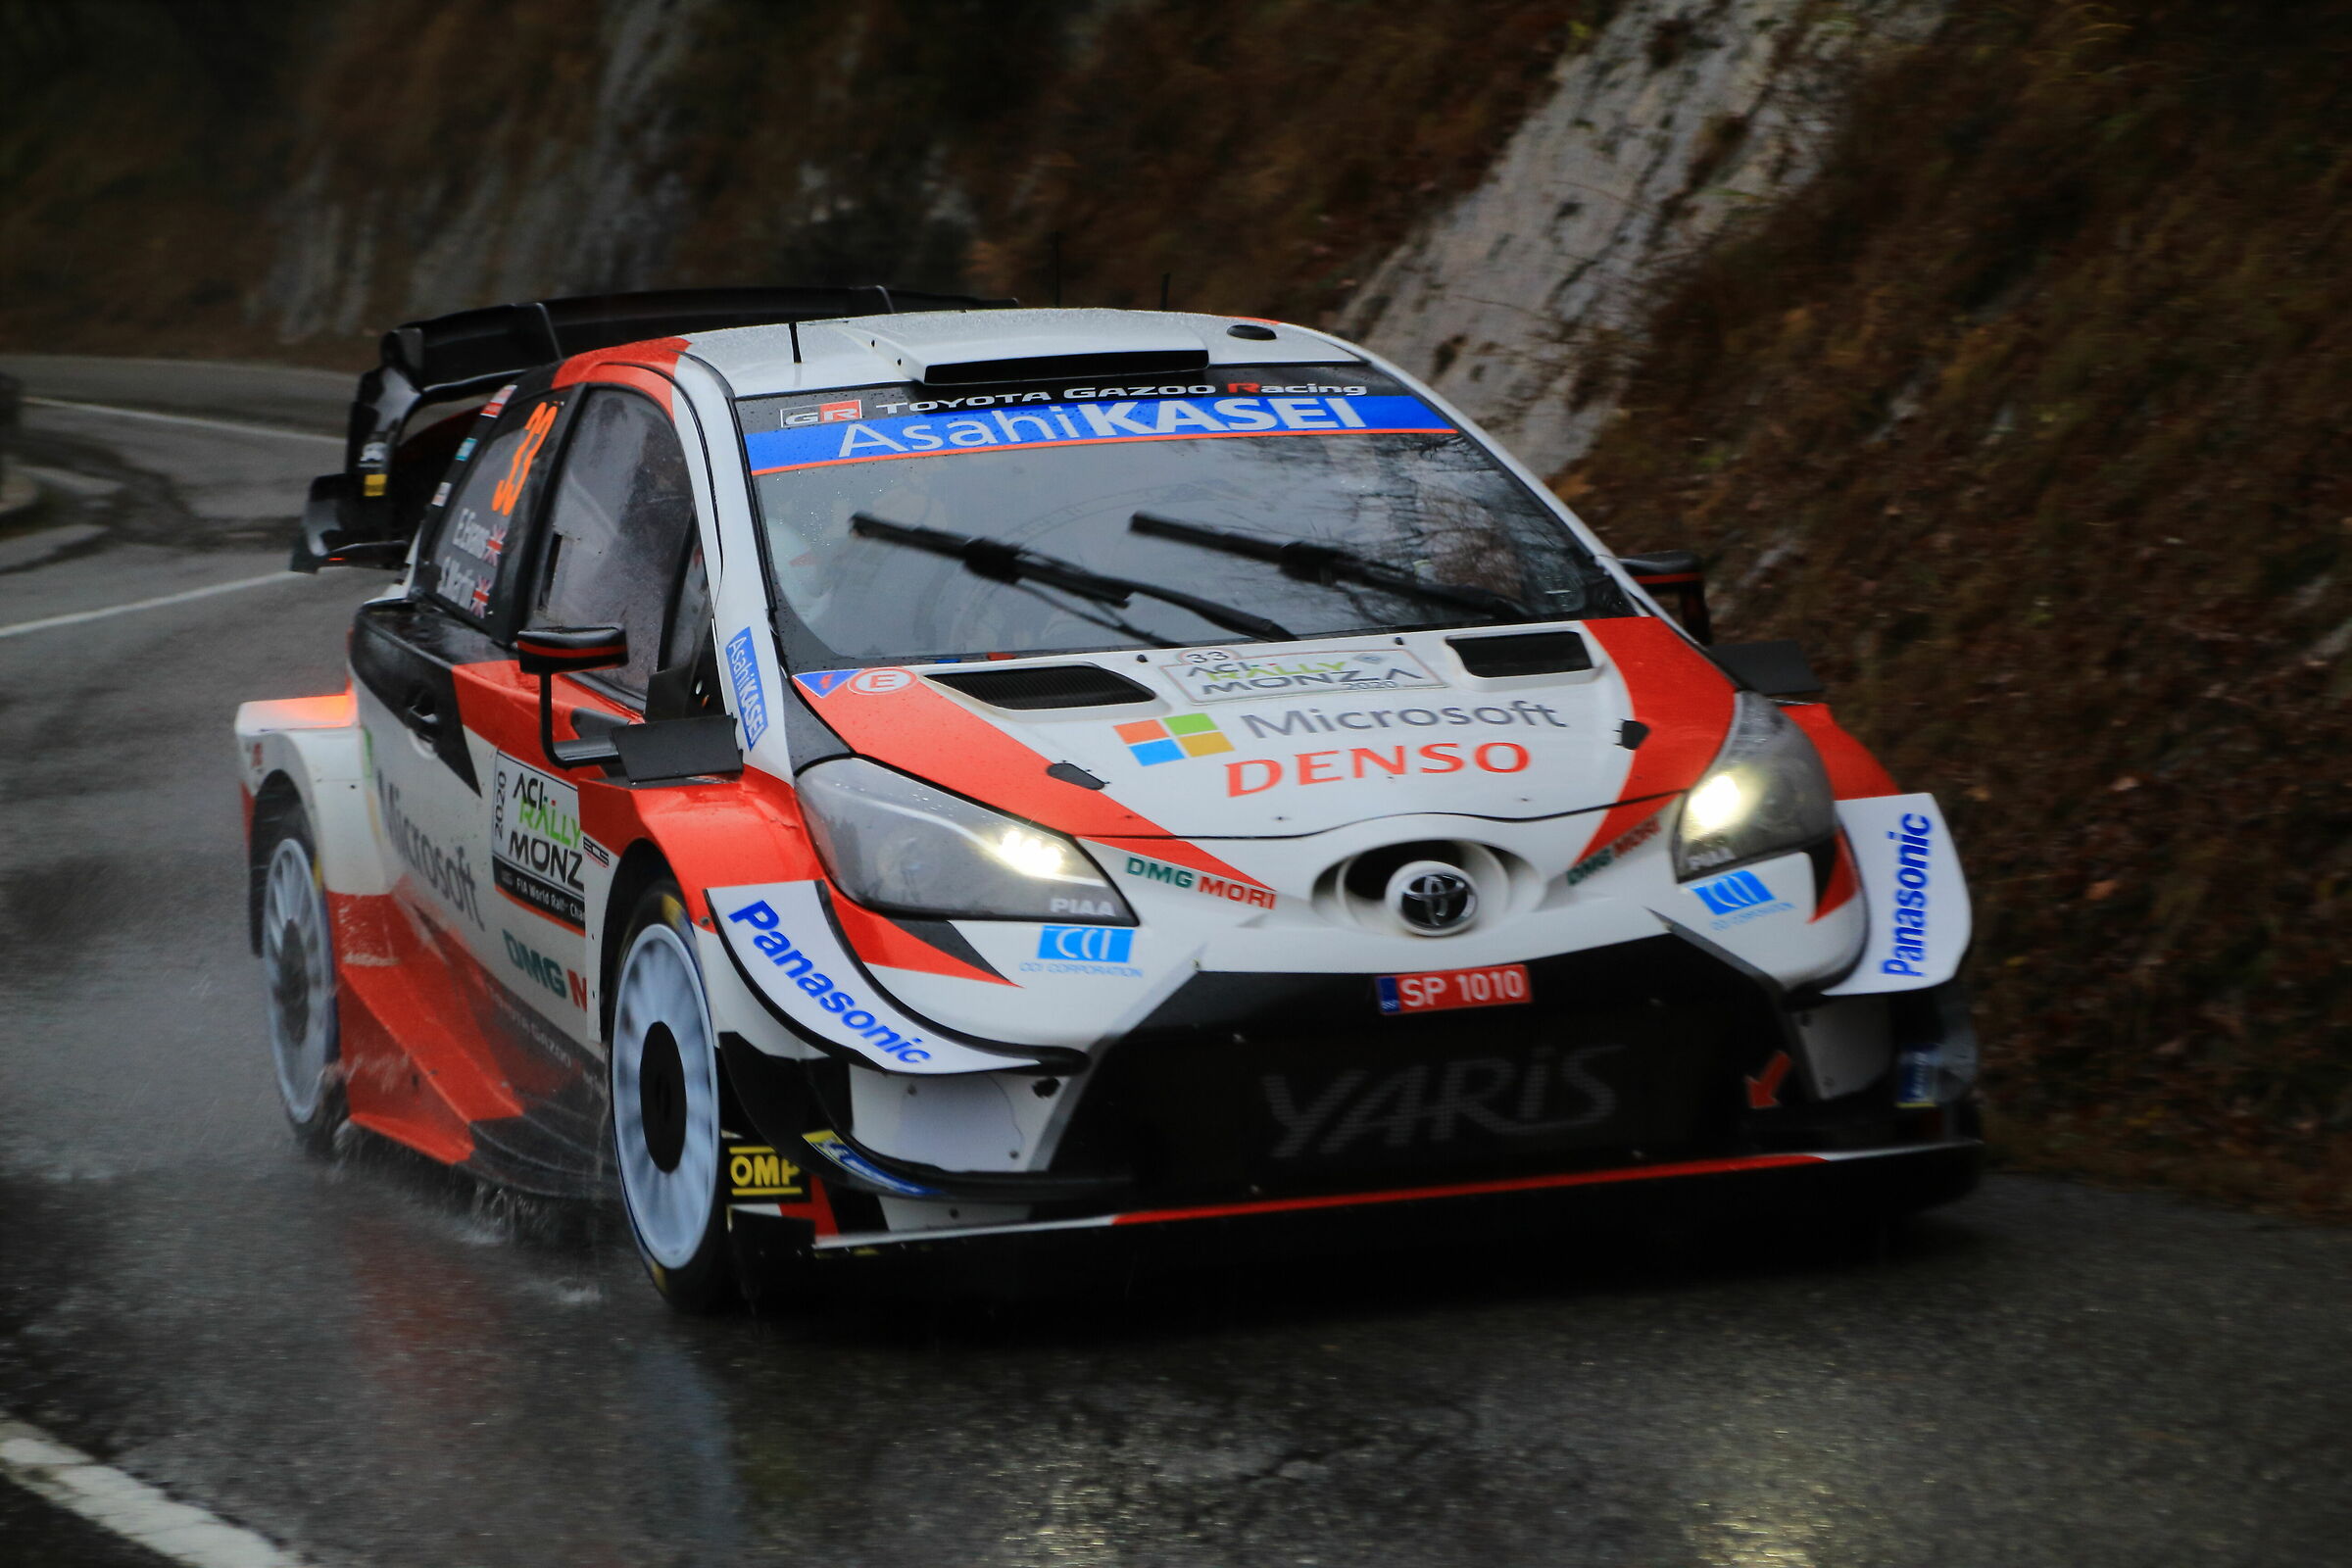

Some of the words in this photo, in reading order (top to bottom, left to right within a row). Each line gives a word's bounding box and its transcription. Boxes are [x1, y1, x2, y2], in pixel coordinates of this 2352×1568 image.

[785, 408, 858, 425] GR
[876, 391, 1052, 415] TOYOTA
[1063, 384, 1216, 399] GAZOO
[1227, 382, 1367, 396] Racing
[1187, 651, 1229, 663] 33
[1206, 661, 1347, 681] RALLY
[869, 673, 896, 689] E
[1202, 668, 1423, 695] MONZA
[1241, 700, 1569, 740] Microsoft
[1224, 742, 1531, 798] DENSO
[495, 771, 506, 841] 2020
[513, 772, 544, 810] ACI
[518, 800, 580, 850] RALLY
[1126, 855, 1193, 889] DMG
[1199, 875, 1275, 909] MORI
[1880, 812, 1934, 978] Panasonic
[1050, 898, 1116, 916] PIAA
[502, 928, 566, 1000] DMG
[727, 900, 933, 1065] Panasonic
[1400, 976, 1447, 1007] SP
[1455, 969, 1525, 1003] 1010
[730, 1153, 802, 1188] OMP
